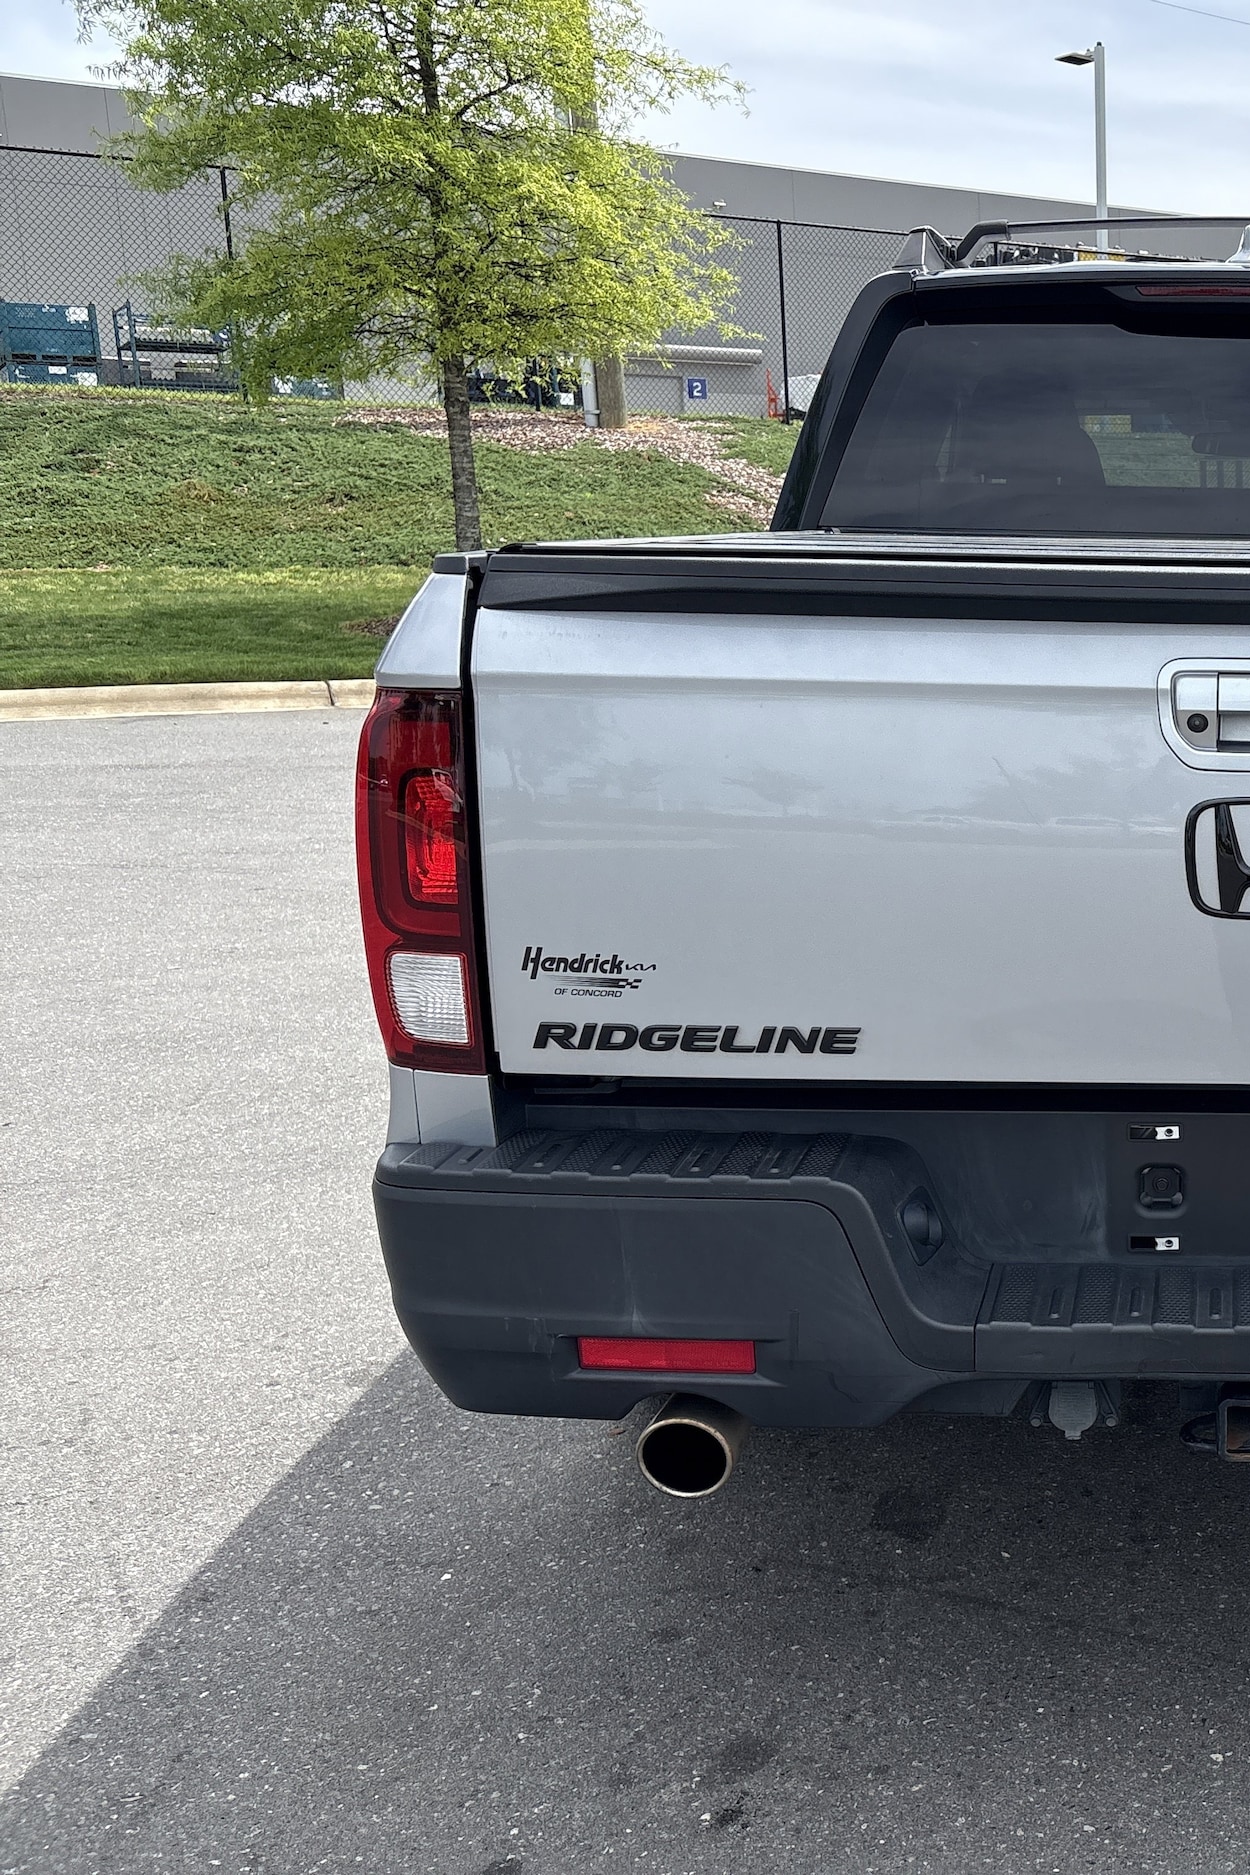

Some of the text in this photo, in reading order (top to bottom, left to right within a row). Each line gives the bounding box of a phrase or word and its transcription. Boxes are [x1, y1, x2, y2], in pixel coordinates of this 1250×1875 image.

[692, 381, 703, 397] 2
[521, 946, 624, 980] Hendrick
[554, 987, 623, 998] OF CONCORD
[532, 1021, 861, 1055] RIDGELINE
